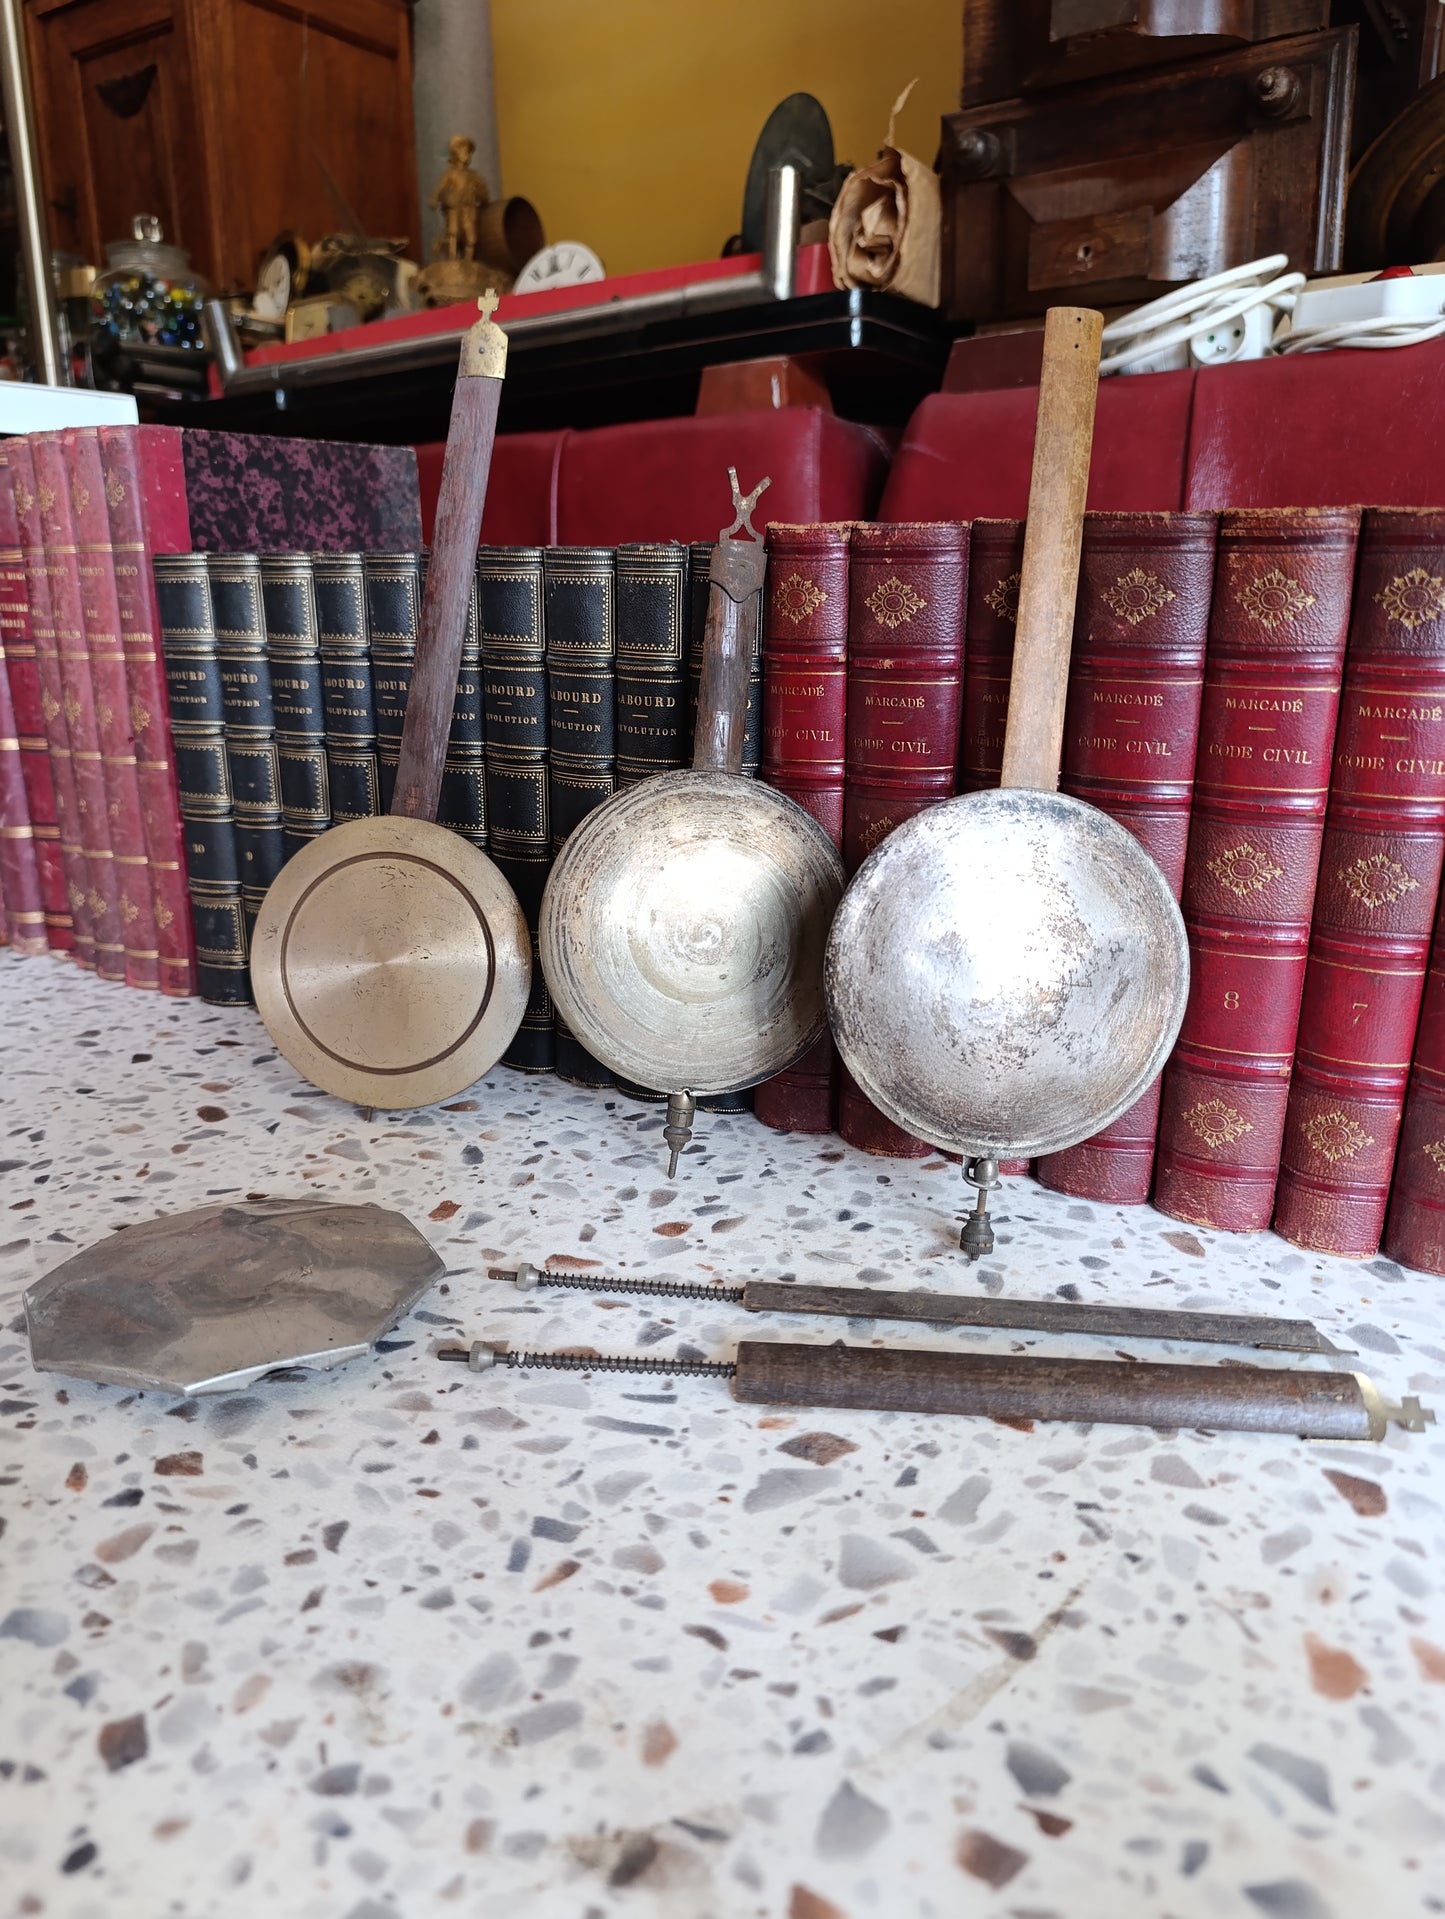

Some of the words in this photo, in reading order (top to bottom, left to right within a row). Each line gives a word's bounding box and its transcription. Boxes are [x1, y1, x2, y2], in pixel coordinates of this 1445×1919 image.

[485, 683, 536, 697] ABOURD
[550, 689, 602, 704] ABOURD
[770, 684, 825, 697] MARCADÉ
[864, 695, 925, 709] MARCADÉ
[1093, 692, 1164, 707] MARCADÉ
[1225, 697, 1303, 713] MARCADÉ
[1358, 705, 1444, 721] MARCADÉ
[796, 729, 834, 742] CIVIL
[854, 737, 884, 750] CODE
[891, 740, 931, 754] CIVIL
[1078, 735, 1117, 750] CODE
[1125, 739, 1171, 756] CIVIL
[1209, 743, 1253, 759] CODE
[1263, 748, 1312, 765] CIVIL
[1338, 753, 1385, 770] CODE
[1395, 758, 1445, 776] CIVIL
[1223, 991, 1240, 1010] 8
[1352, 1002, 1369, 1026] 7
